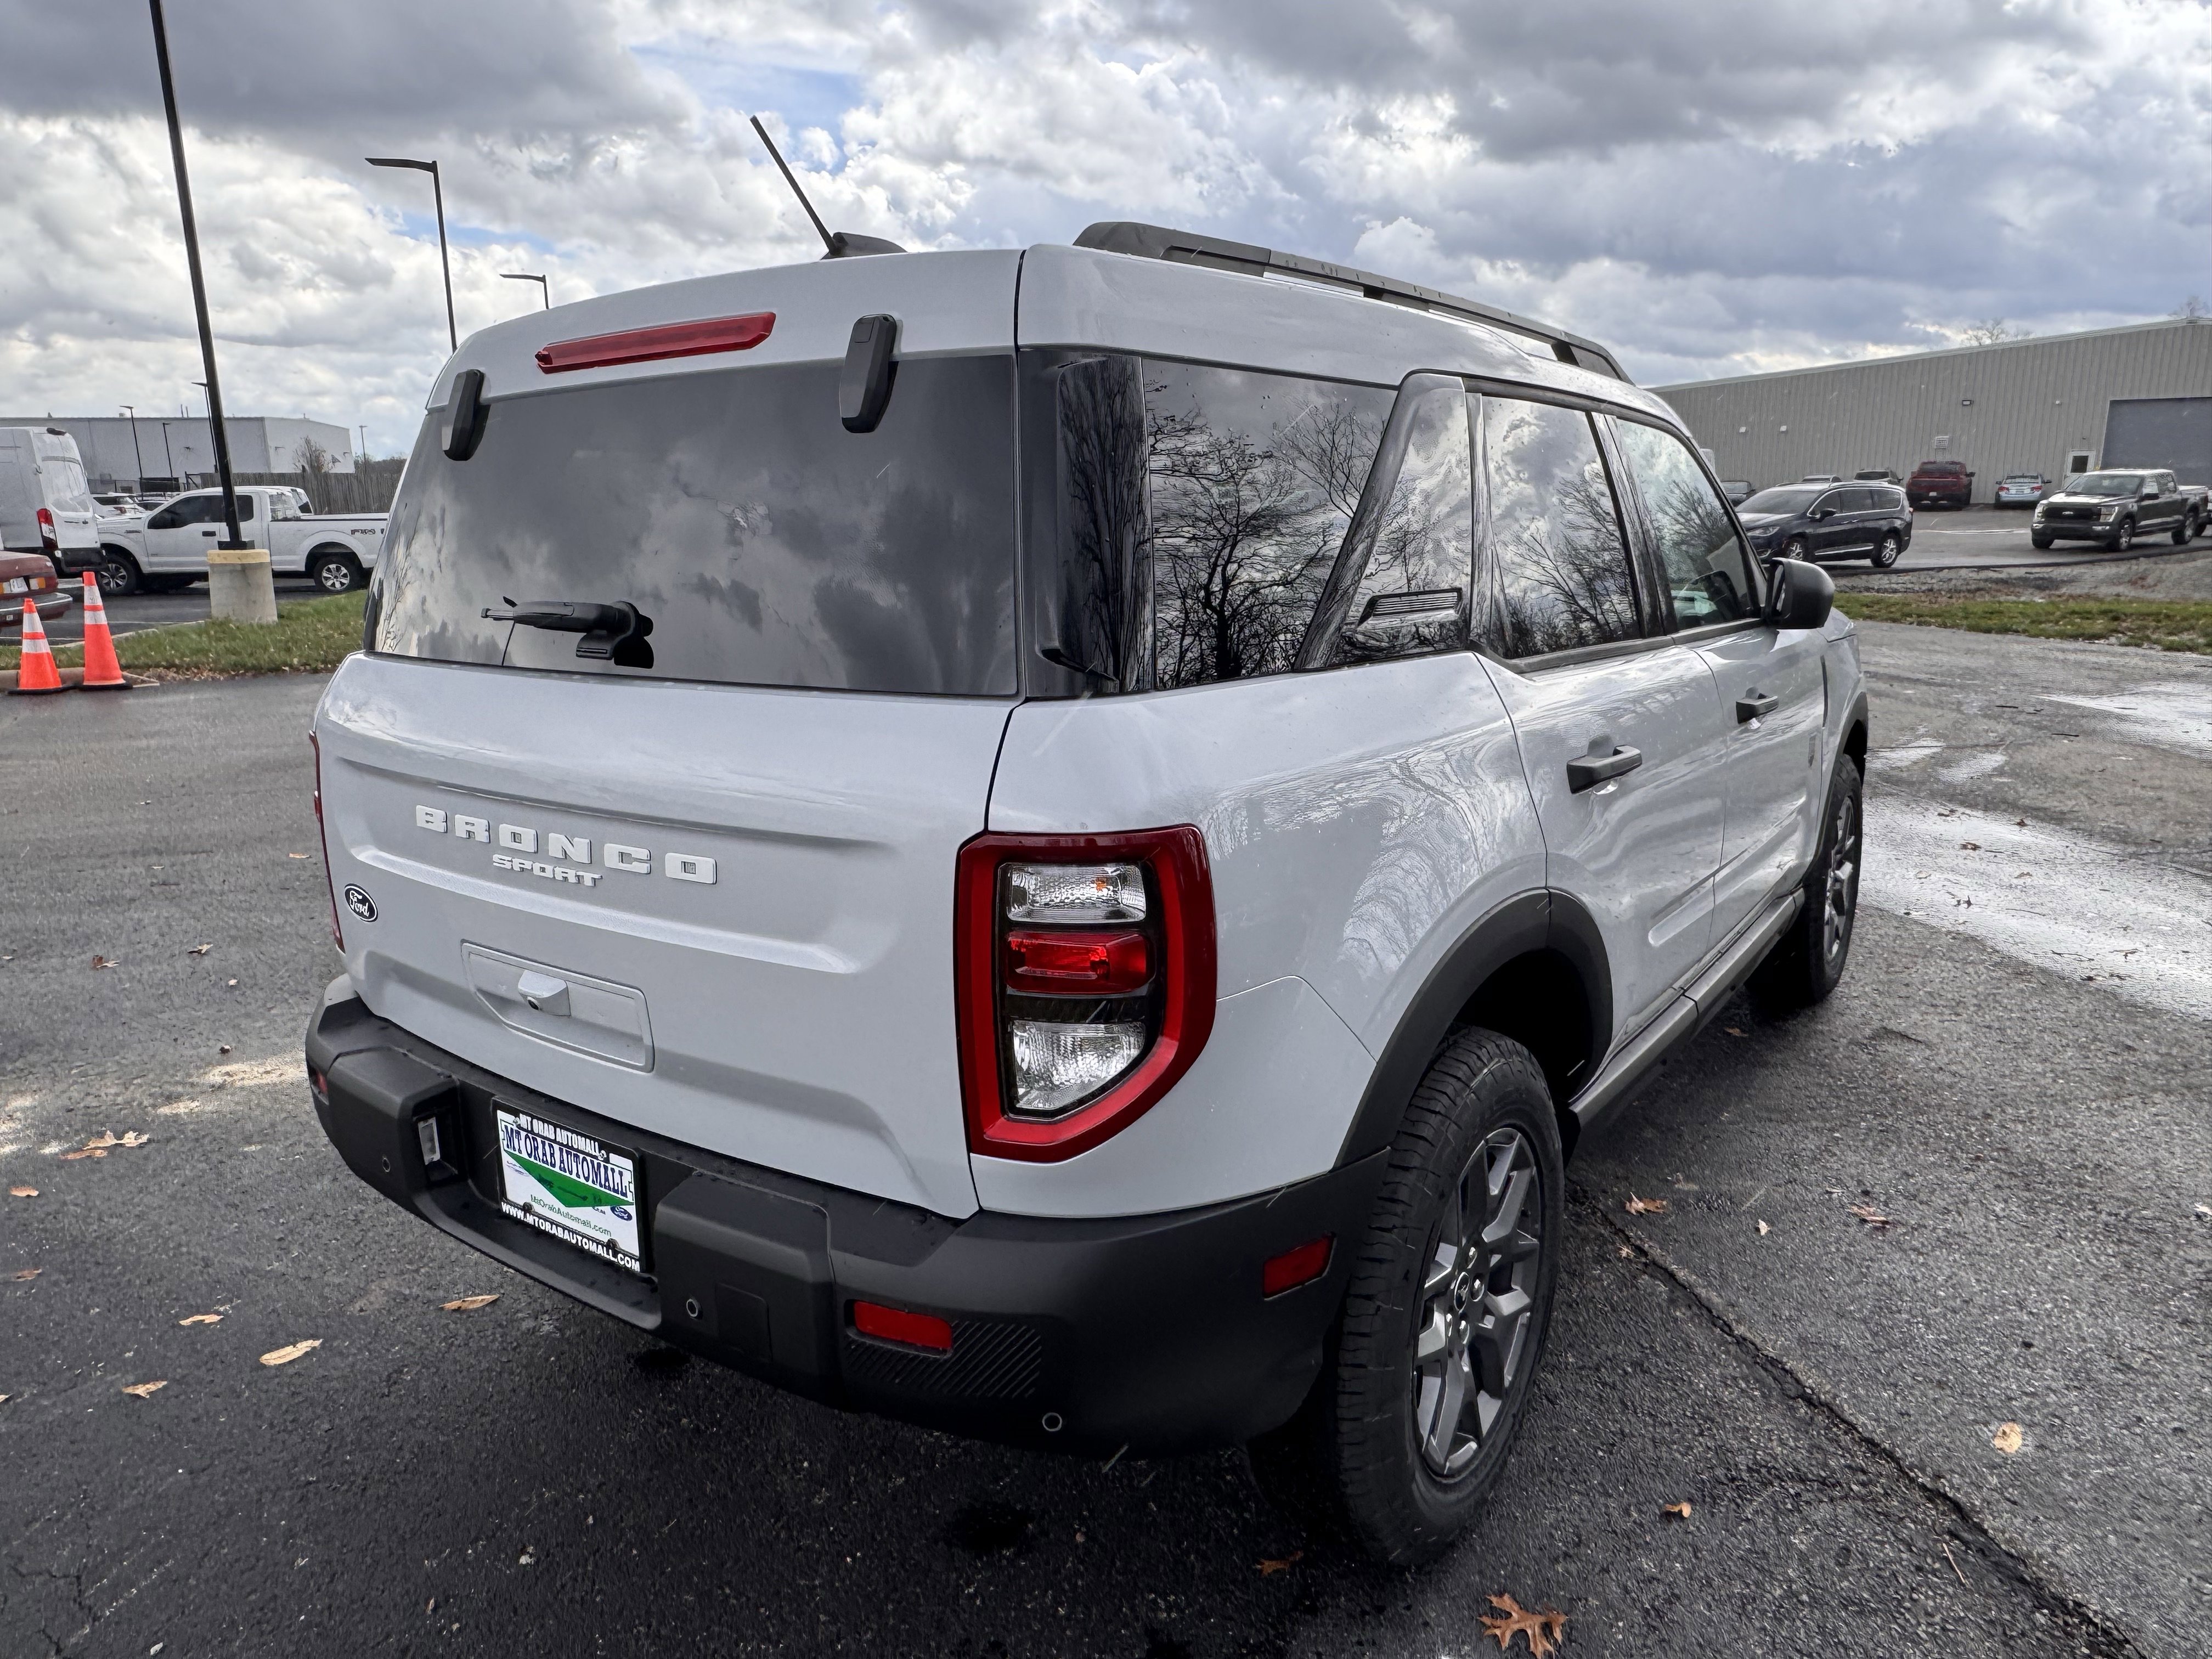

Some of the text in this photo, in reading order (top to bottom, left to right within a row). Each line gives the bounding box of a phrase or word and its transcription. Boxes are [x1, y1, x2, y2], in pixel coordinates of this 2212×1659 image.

[416, 805, 717, 884] BRONCO
[493, 854, 603, 887] SPORT
[504, 1124, 628, 1198] MT ORAB AUTOMALL
[519, 1113, 600, 1157] MT ORAB AUTOMALL
[501, 1201, 641, 1272] WWW.MTORABAUTOMALL.COM
